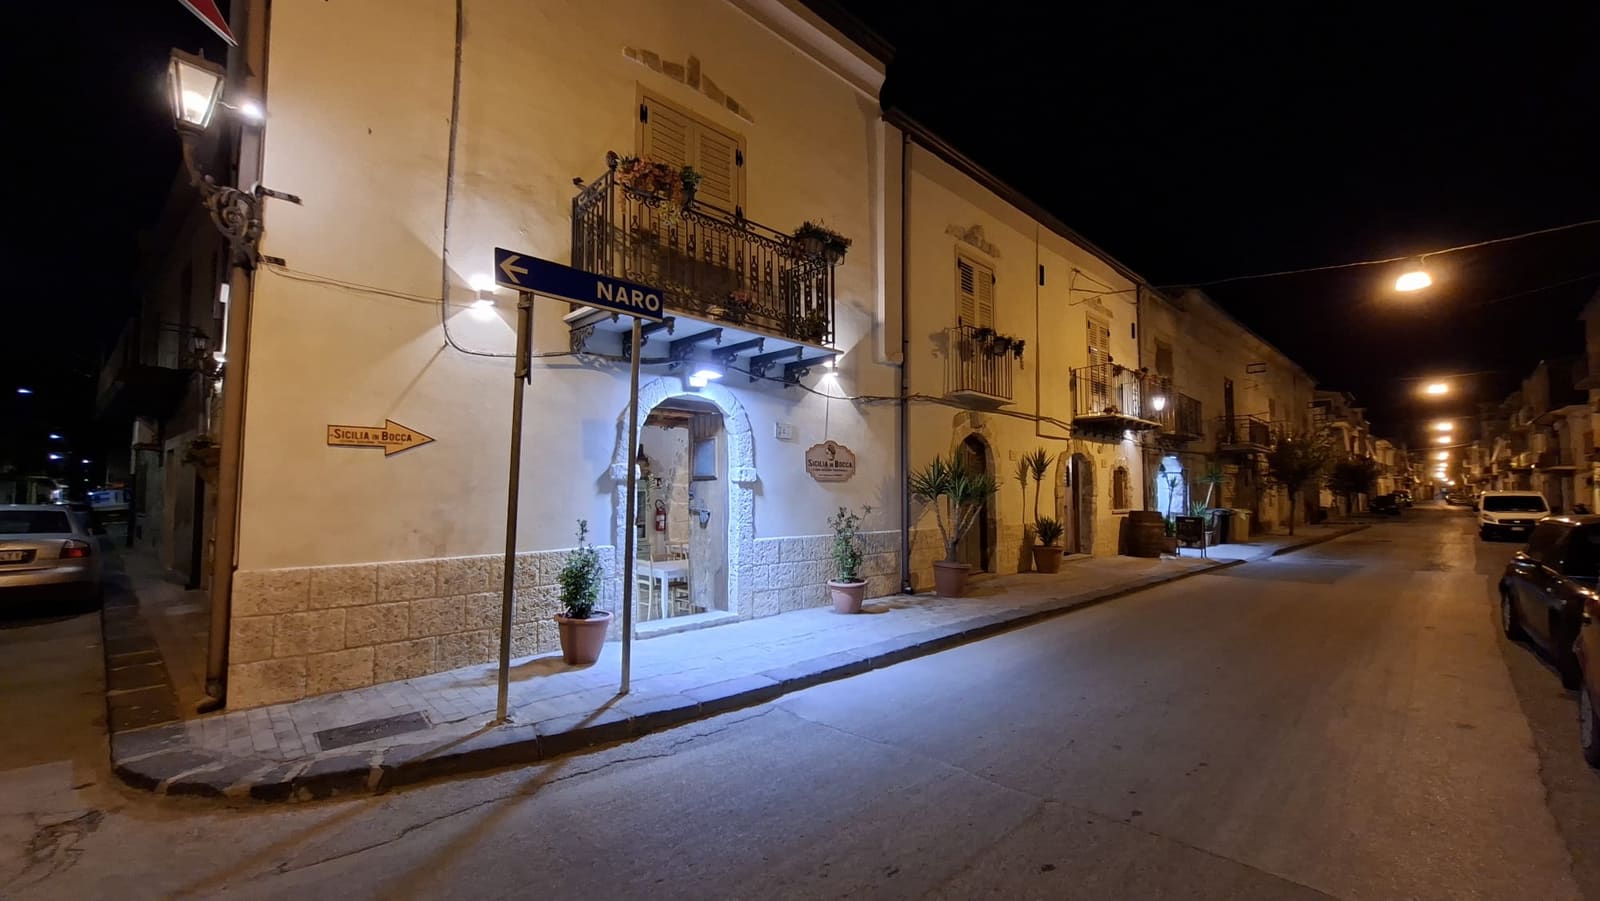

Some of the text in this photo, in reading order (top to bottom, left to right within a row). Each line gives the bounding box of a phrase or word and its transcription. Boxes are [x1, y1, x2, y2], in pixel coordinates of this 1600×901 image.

[597, 281, 659, 311] NARO
[334, 428, 369, 440] SICILIA
[381, 431, 412, 442] BOCCA
